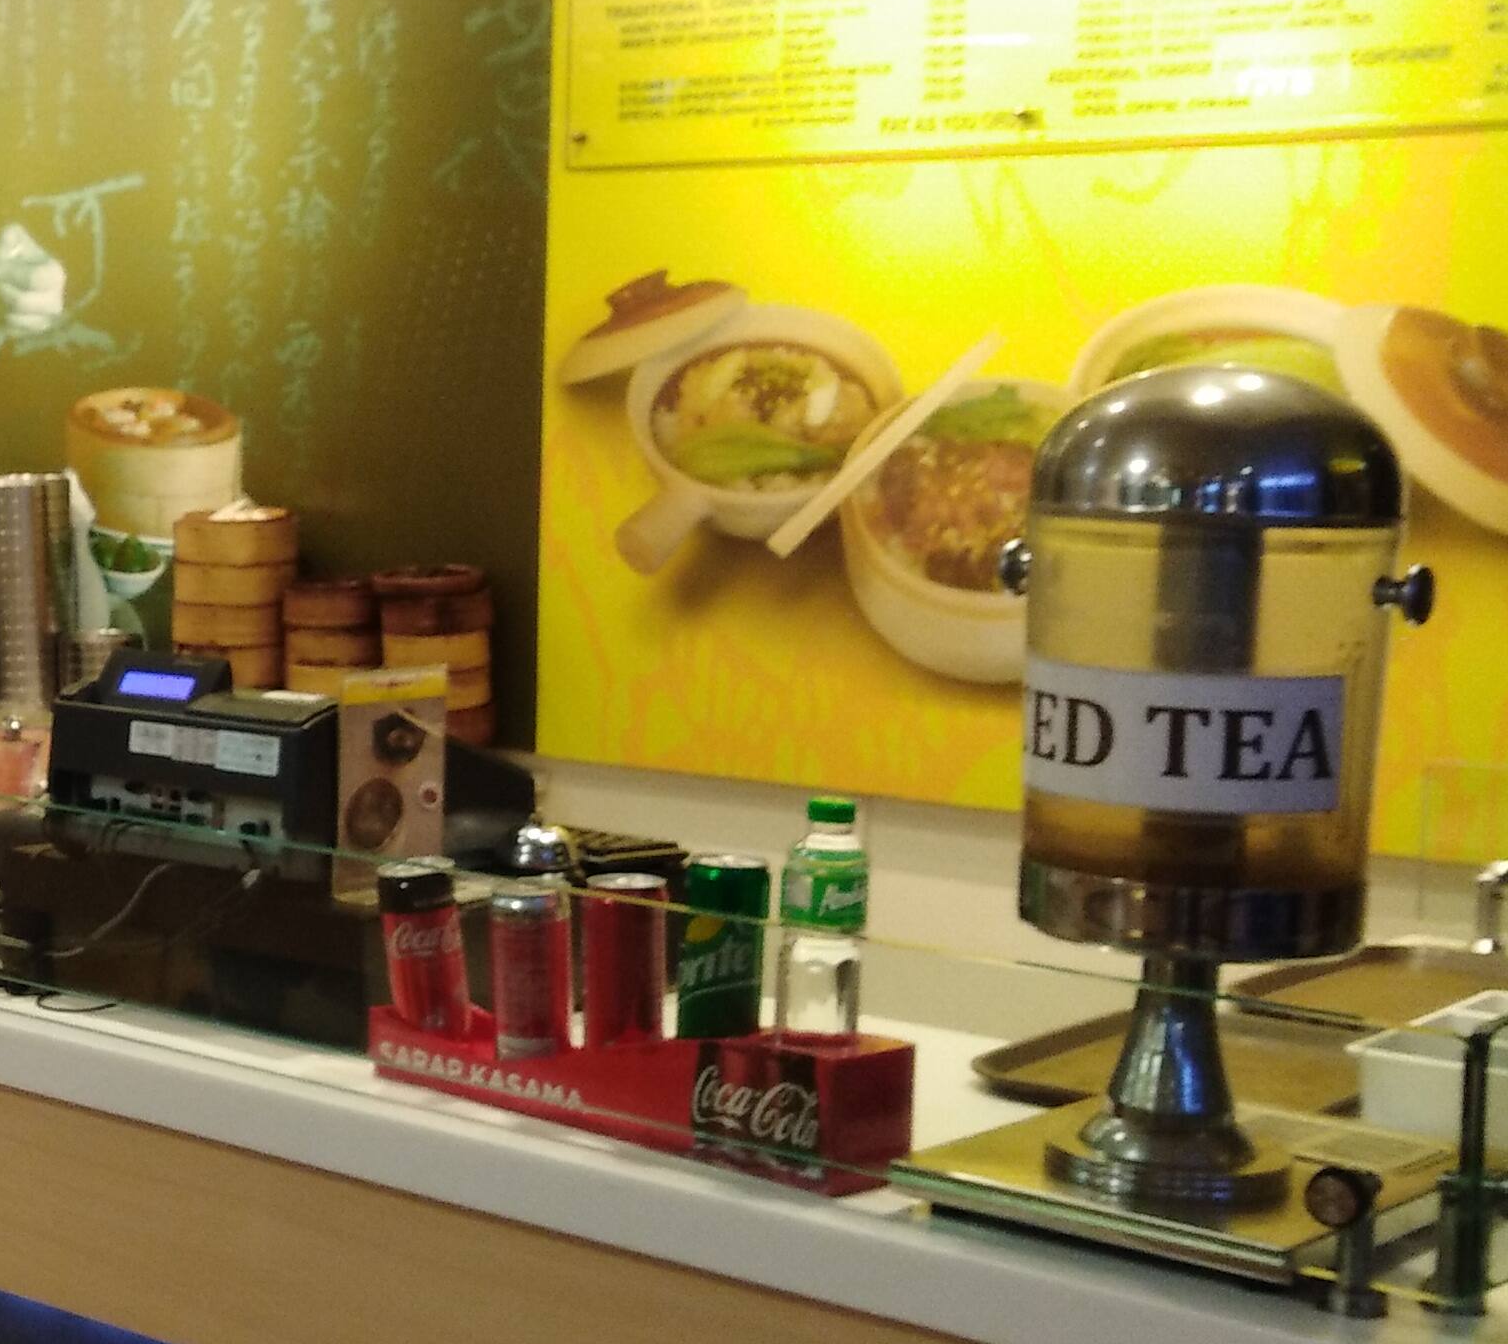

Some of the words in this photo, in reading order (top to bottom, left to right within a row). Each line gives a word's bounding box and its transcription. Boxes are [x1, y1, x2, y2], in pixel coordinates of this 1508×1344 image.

[1028, 688, 1114, 767] ED
[1146, 706, 1332, 781] TEA
[692, 1064, 819, 1148] Coca-Cola
